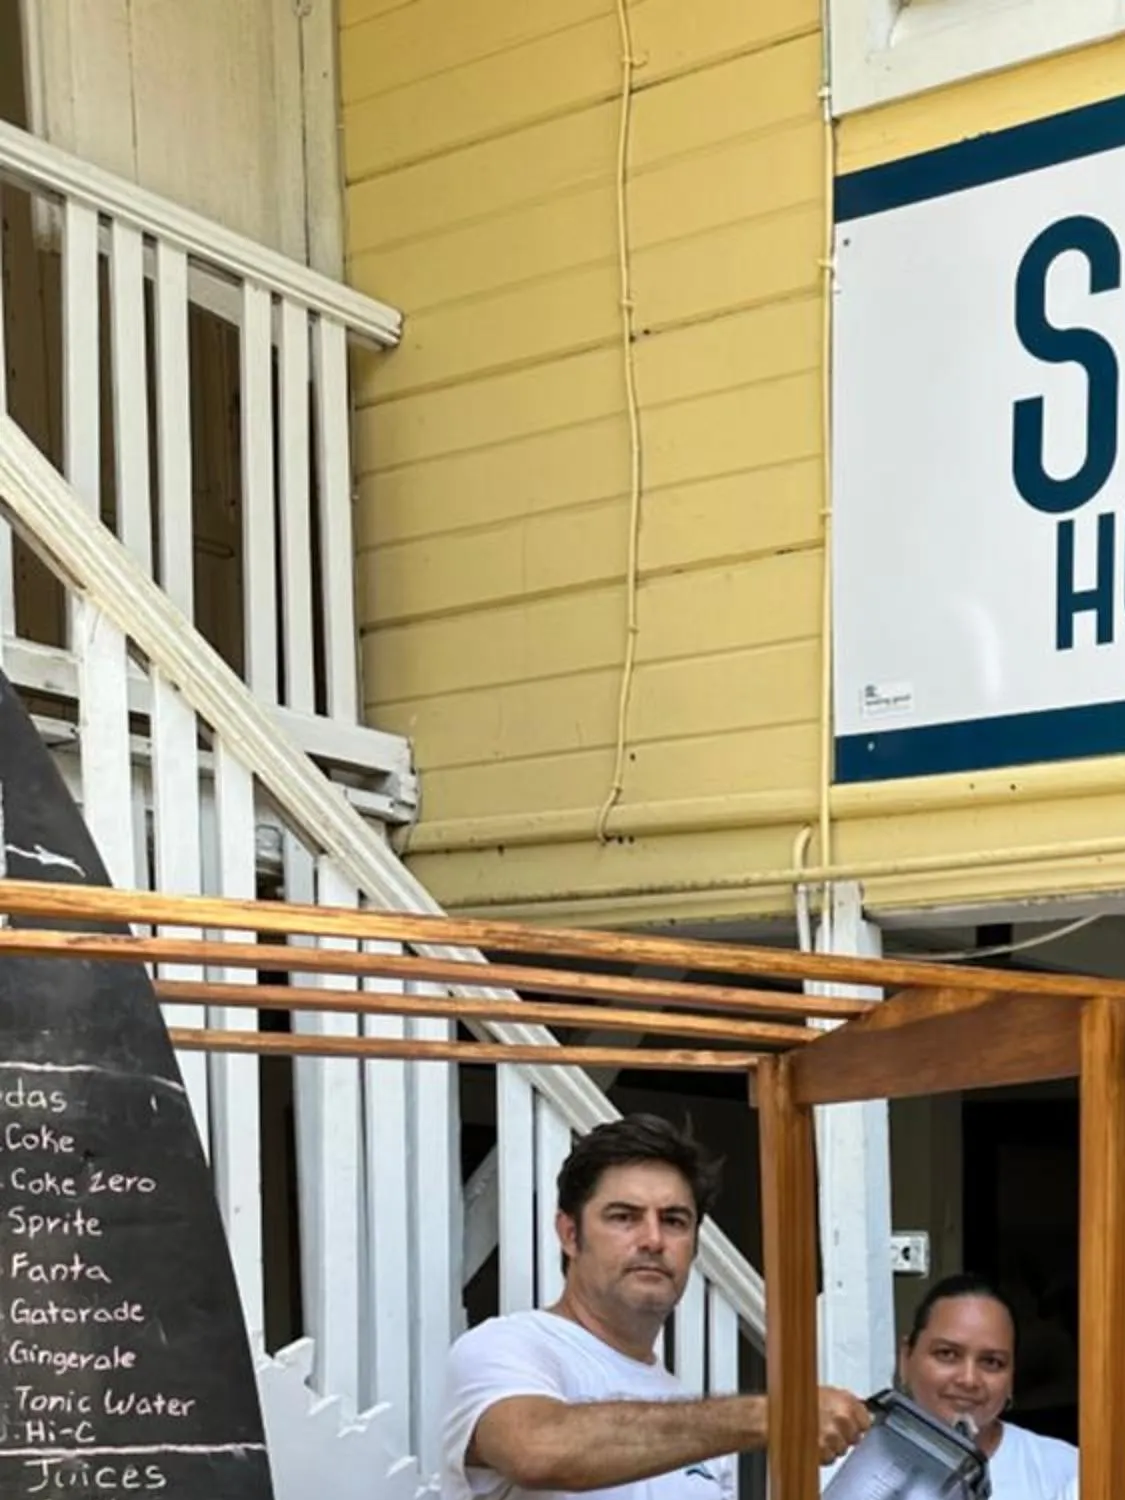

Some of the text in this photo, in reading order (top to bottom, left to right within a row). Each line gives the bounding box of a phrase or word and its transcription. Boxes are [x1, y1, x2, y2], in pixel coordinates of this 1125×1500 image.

[0, 1077, 68, 1113] das
[5, 1123, 75, 1153] Coke
[11, 1167, 76, 1195] Coke
[8, 1206, 103, 1239] Sprite
[11, 1252, 112, 1283] Fanta
[10, 1297, 145, 1325] Gatorade
[9, 1340, 137, 1374] Gingerale
[15, 1385, 197, 1416] Tonic Water
[26, 1420, 95, 1443] Hi-C
[24, 1457, 167, 1493] Juices
